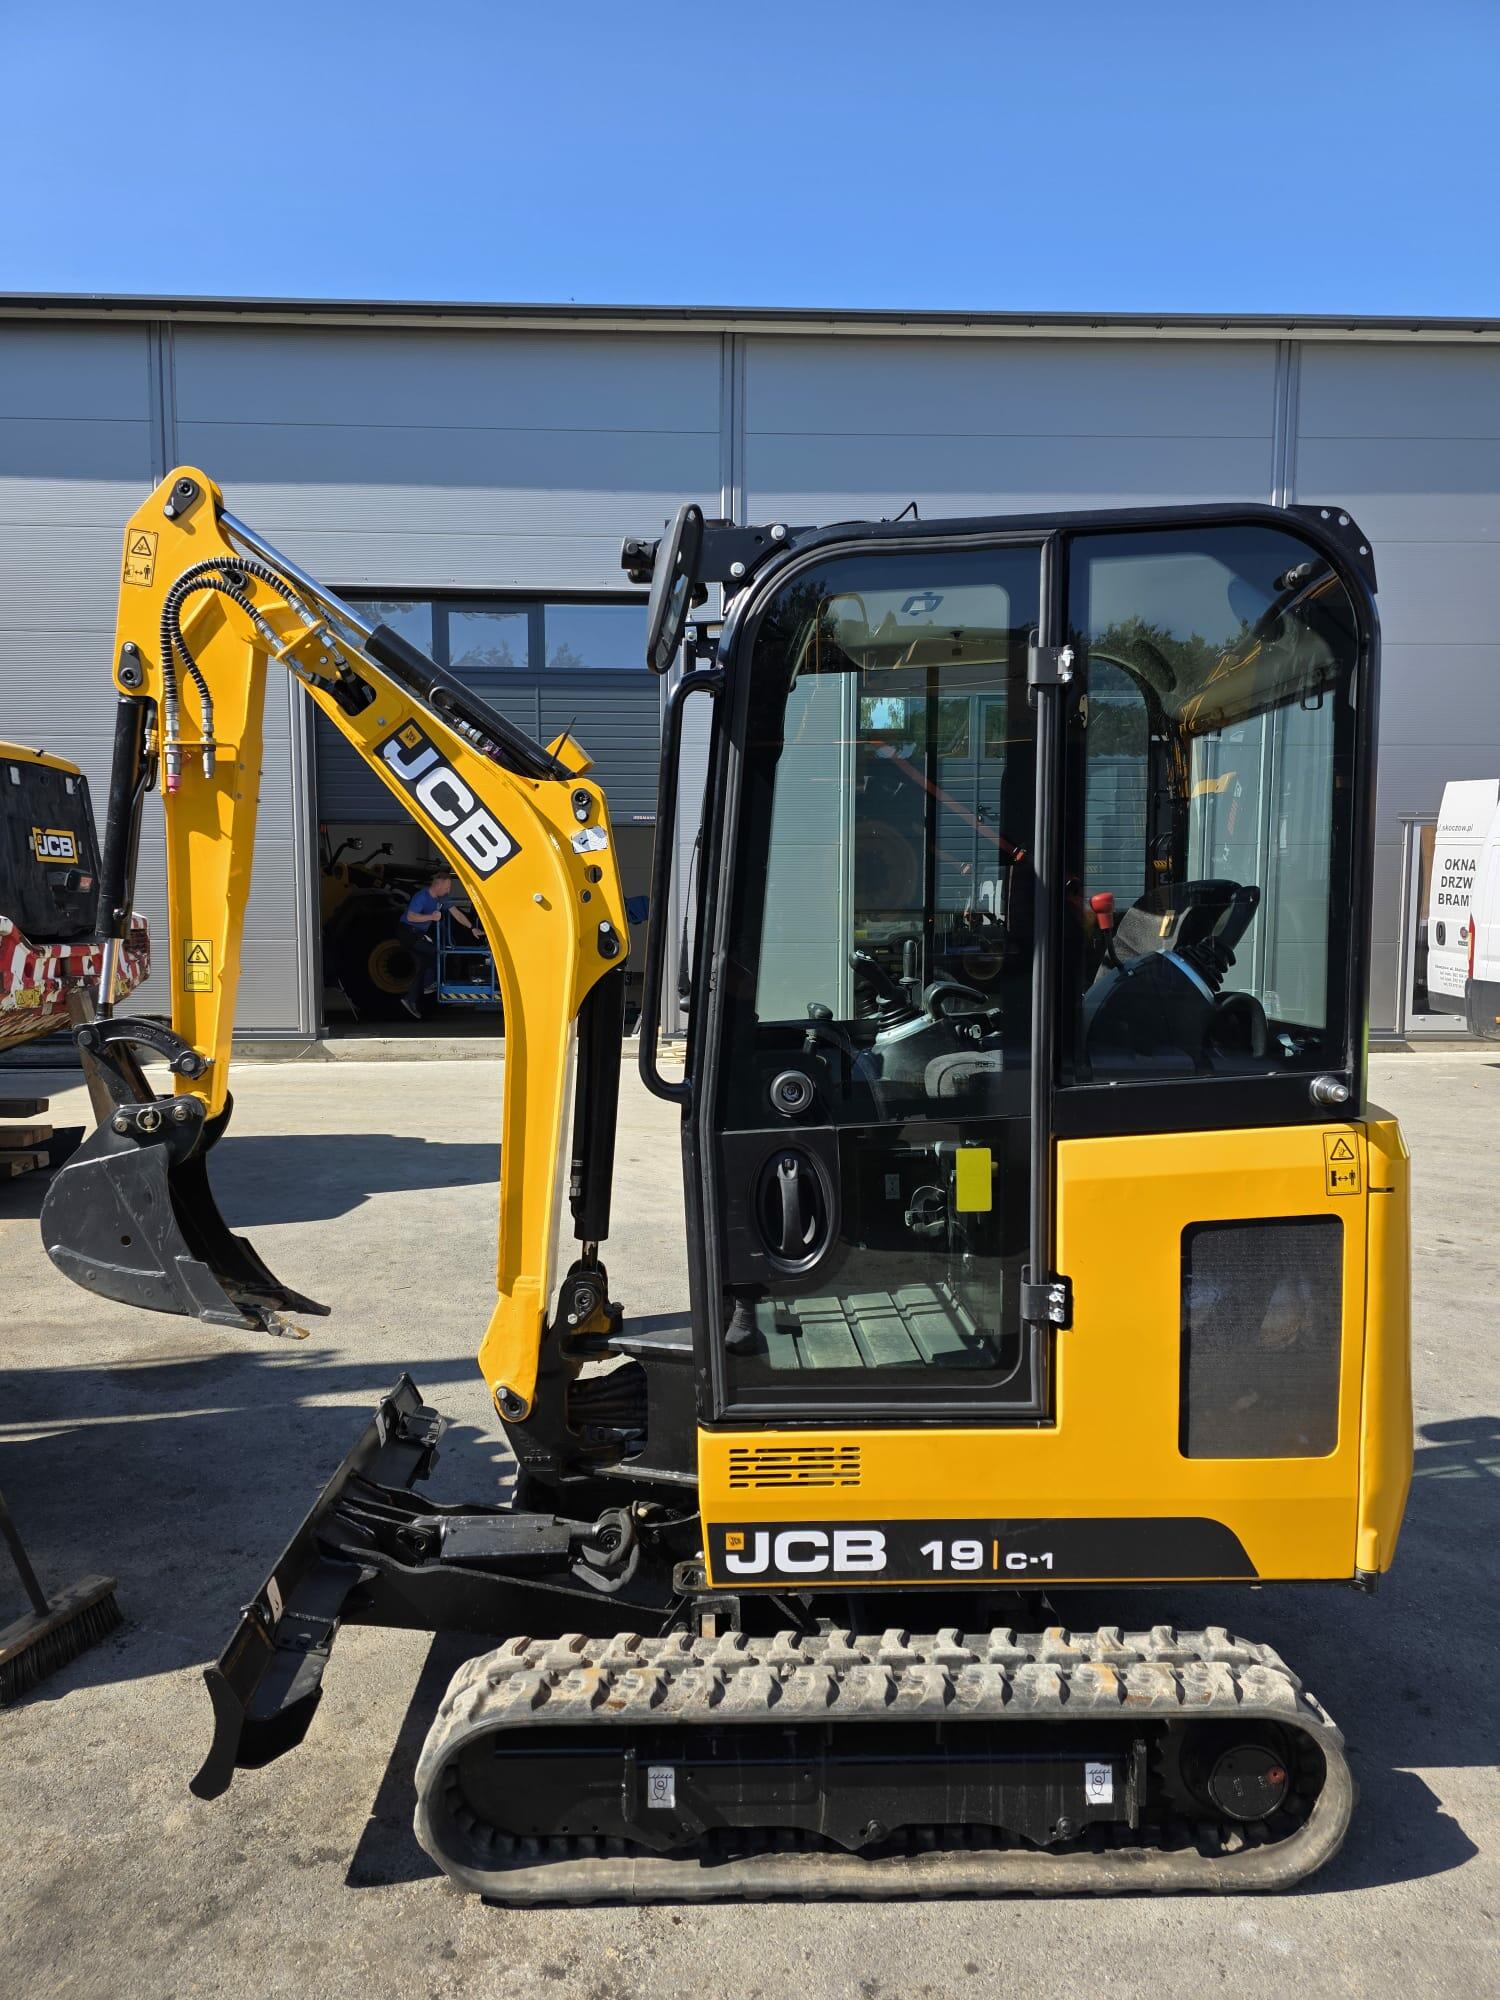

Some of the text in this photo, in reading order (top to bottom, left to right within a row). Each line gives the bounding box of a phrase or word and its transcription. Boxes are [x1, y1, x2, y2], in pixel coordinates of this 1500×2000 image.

[383, 739, 512, 872] JCB
[38, 835, 74, 857] JCB
[1444, 858, 1476, 872] OKNA
[1440, 875, 1474, 889] DRZW
[1437, 892, 1472, 907] BRAM
[725, 1530, 887, 1574] JCB
[919, 1539, 984, 1571] 19
